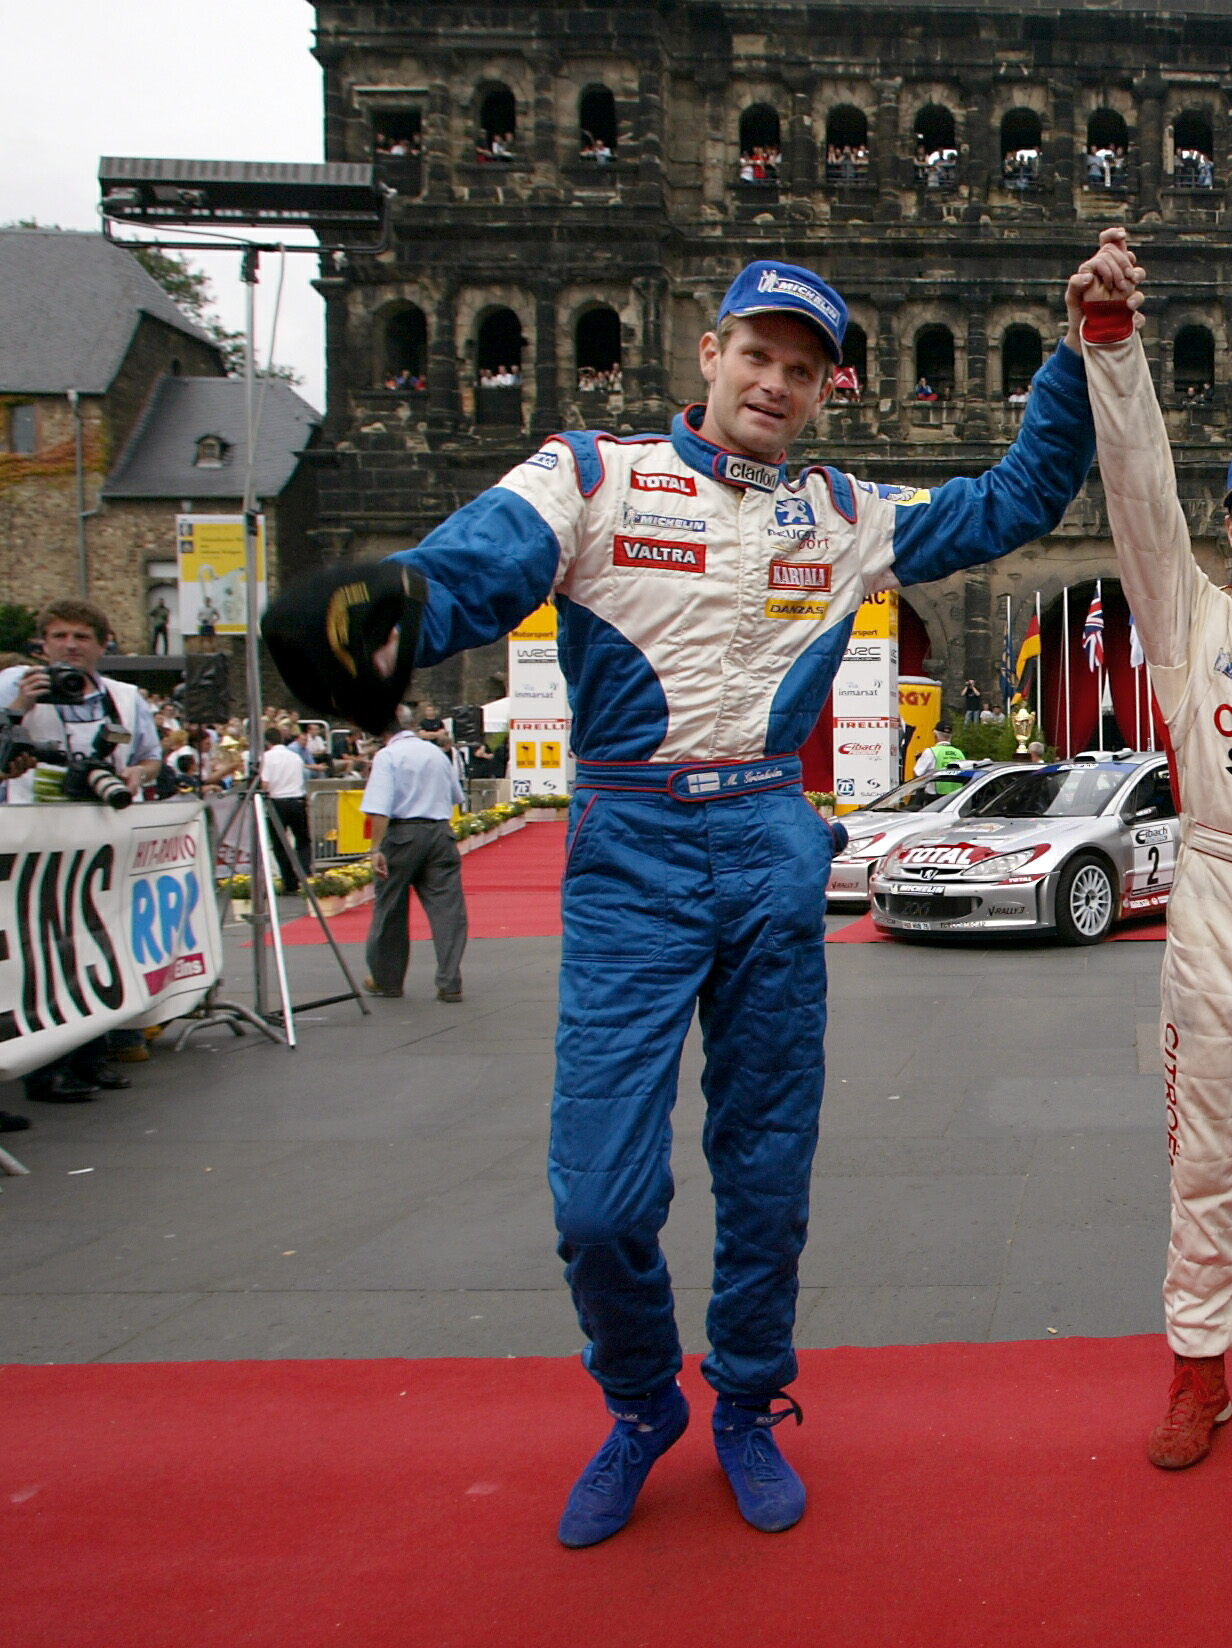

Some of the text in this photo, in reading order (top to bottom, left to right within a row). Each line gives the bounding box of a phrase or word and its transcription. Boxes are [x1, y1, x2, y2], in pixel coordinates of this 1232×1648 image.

[778, 282, 838, 319] MICHELIN
[635, 474, 691, 493] TOTAL
[640, 515, 705, 530] MICHELIN
[623, 541, 697, 565] VALTRA
[517, 648, 558, 658] WRC
[838, 689, 878, 697] inmarsat
[510, 718, 567, 730] PIRELLI
[833, 716, 889, 729] PIRELLI
[838, 742, 882, 755] Eibach
[1135, 827, 1168, 845] Eibach
[903, 848, 974, 865] TOTAL
[1147, 846, 1160, 886] 2
[900, 885, 945, 895] MICHELIN
[174, 957, 204, 979] Eins
